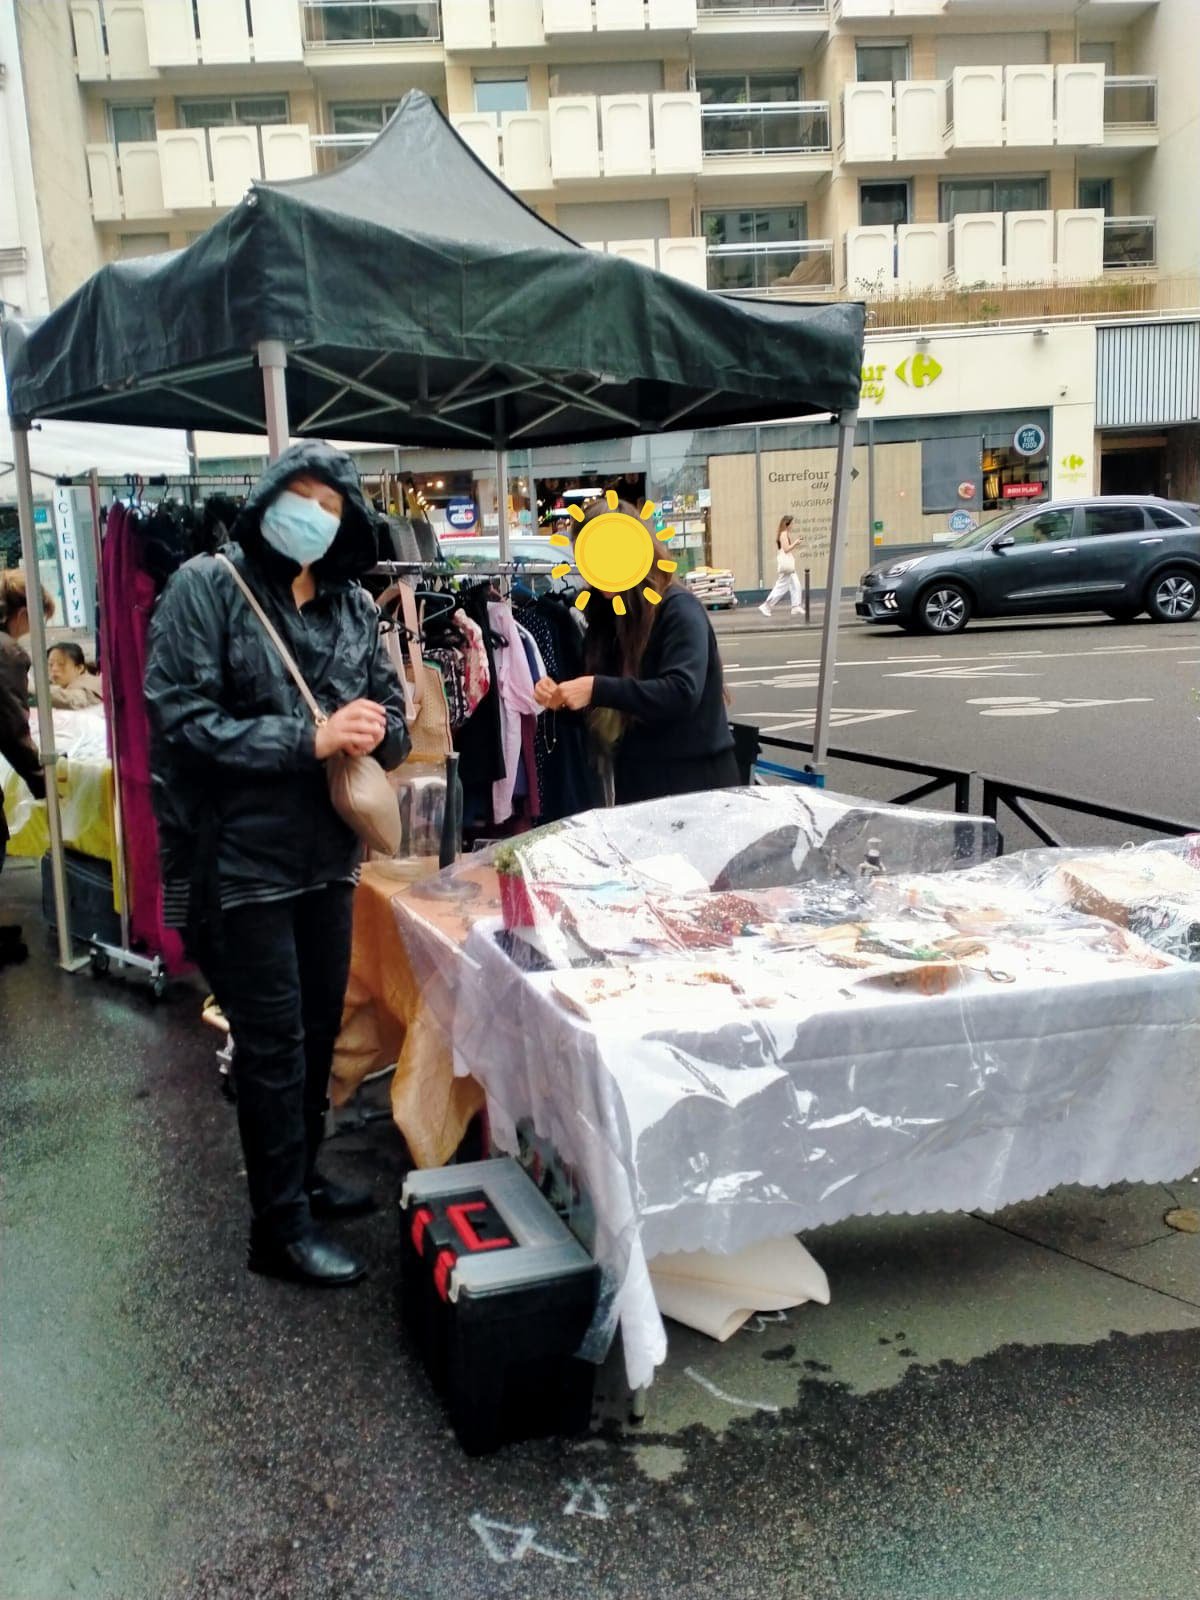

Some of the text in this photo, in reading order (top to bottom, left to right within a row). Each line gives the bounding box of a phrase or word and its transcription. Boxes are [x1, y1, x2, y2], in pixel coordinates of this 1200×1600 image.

[861, 383, 886, 405] ity
[1022, 441, 1038, 449] FOOD
[768, 469, 830, 483] Carrefour
[811, 481, 829, 491] city
[791, 498, 833, 507] VAUGIRAR
[58, 489, 81, 624] ICIEN Krys
